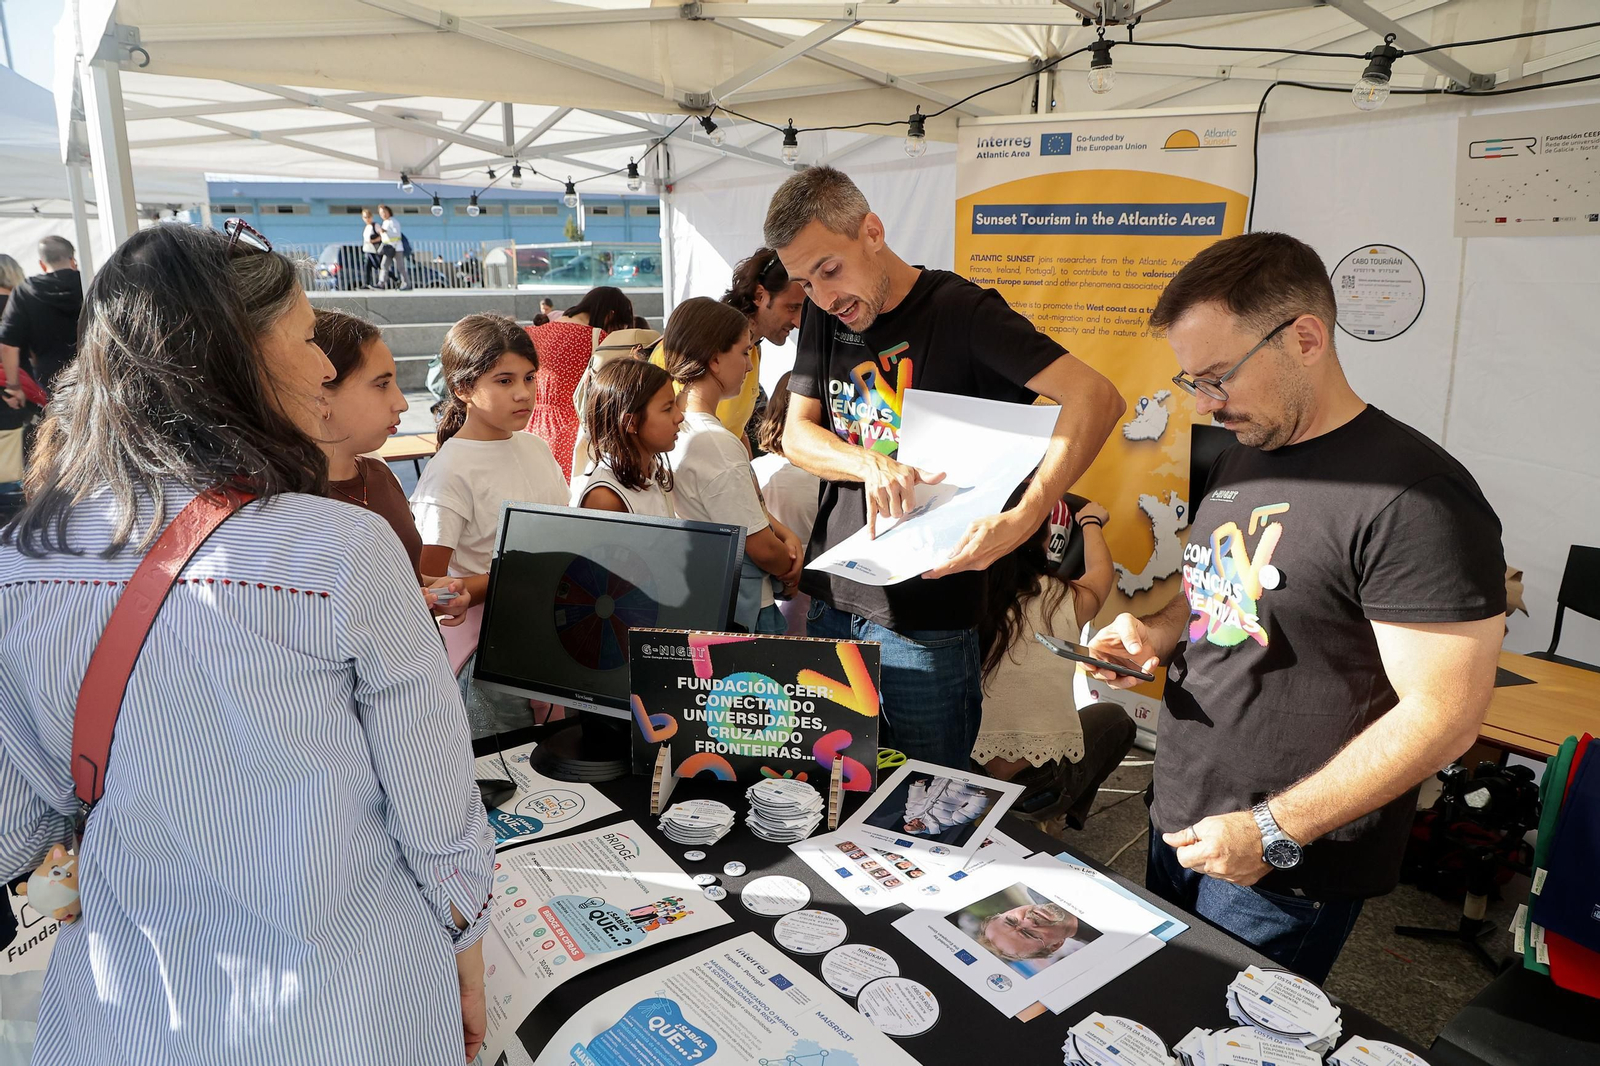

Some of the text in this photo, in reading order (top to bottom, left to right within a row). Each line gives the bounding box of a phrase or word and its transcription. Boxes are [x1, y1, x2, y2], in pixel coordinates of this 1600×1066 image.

[1076, 133, 1125, 143] Co-funded by
[1204, 127, 1237, 137] Atlantic
[1545, 133, 1582, 141] Fundación
[977, 136, 1032, 149] Interreg
[1076, 142, 1147, 153] the European Union
[976, 149, 1030, 159] Atlantic Area
[976, 211, 1216, 227] Sunset Tourism in the Atlantic Area
[970, 254, 1167, 266] ATLANTIC SUNSET joins researchers from the Atlantic
[1352, 257, 1369, 265] CABO
[969, 265, 992, 274] France,
[996, 265, 1021, 275] Ireland,
[1060, 267, 1069, 275] to
[1072, 267, 1108, 276] contribute
[1112, 269, 1120, 277] to
[1125, 268, 1137, 277] the
[969, 276, 996, 285] Western
[996, 277, 1021, 287] Europe
[1044, 278, 1058, 286] and
[1060, 278, 1078, 287] other
[1079, 279, 1121, 289] phenomena
[1122, 281, 1164, 290] associated
[1042, 302, 1072, 310] promote
[1074, 302, 1085, 310] the
[1086, 303, 1104, 312] West
[1105, 305, 1126, 313] coast
[1038, 314, 1083, 323] out-migration
[1086, 315, 1100, 323] and
[1114, 315, 1144, 328] diversify
[1048, 325, 1079, 335] capacity
[1082, 326, 1095, 334] and
[1099, 326, 1110, 335] the
[1113, 329, 1137, 337] nature
[829, 379, 855, 398] ON
[1050, 533, 1065, 554] hp
[1184, 542, 1212, 566] CON
[1183, 565, 1243, 604] CIENCIAS
[641, 643, 706, 658] G-NIGHT
[677, 676, 834, 699] FUNDACIÓN CEER:
[695, 693, 815, 714] CONECTANDO
[683, 708, 828, 732] UNIVERSIDADES,
[706, 725, 803, 745] CRUZANDO
[694, 740, 816, 761] FRONTEIRAS...
[534, 800, 549, 812] NEWS
[543, 798, 558, 809] FAKE
[602, 833, 636, 861] BRIDGE
[588, 909, 632, 947] QUE...?
[606, 910, 632, 933] ¿SABÍAS
[542, 909, 580, 956] BRIDGE EN CIFRAS
[735, 946, 771, 975] Interreg
[857, 947, 888, 962] NORDKAPP
[723, 953, 765, 987] España Portugal
[1237, 982, 1258, 995] Interreg
[1273, 974, 1292, 984] COSTA
[1301, 987, 1321, 999] MORTE
[1283, 986, 1297, 994] CATRO
[709, 959, 734, 981] MAISRIS3T:
[733, 980, 769, 1011] MAXIMIZANDO
[773, 1015, 799, 1036] IMPACTO
[710, 968, 753, 1005] SOSTENIBILIDADE
[751, 1004, 761, 1012] DA
[759, 1011, 776, 1025] RIS3T
[1271, 989, 1298, 1004] CONTINENTAL
[1274, 986, 1295, 998] SOLPORES
[1301, 1000, 1319, 1010] EUROPA
[743, 1008, 772, 1033] oportunidades
[815, 1010, 855, 1042] MAISRIS3T
[648, 1016, 703, 1061] QUE...?
[674, 1023, 708, 1049] ¿SABÍAS
[1086, 1031, 1106, 1044] Interreg
[1115, 1019, 1132, 1030] COSTA
[1140, 1034, 1159, 1046] MORTE
[1254, 1029, 1273, 1040] COSTA
[1119, 1039, 1145, 1056] CONTINENTAL
[1123, 1037, 1143, 1050] SOLPORES
[1133, 1038, 1145, 1047] CATRO
[1263, 1046, 1287, 1054] SOLPORES
[1263, 1050, 1295, 1060] CONTINENTAL
[1382, 1044, 1403, 1059] COSTA
